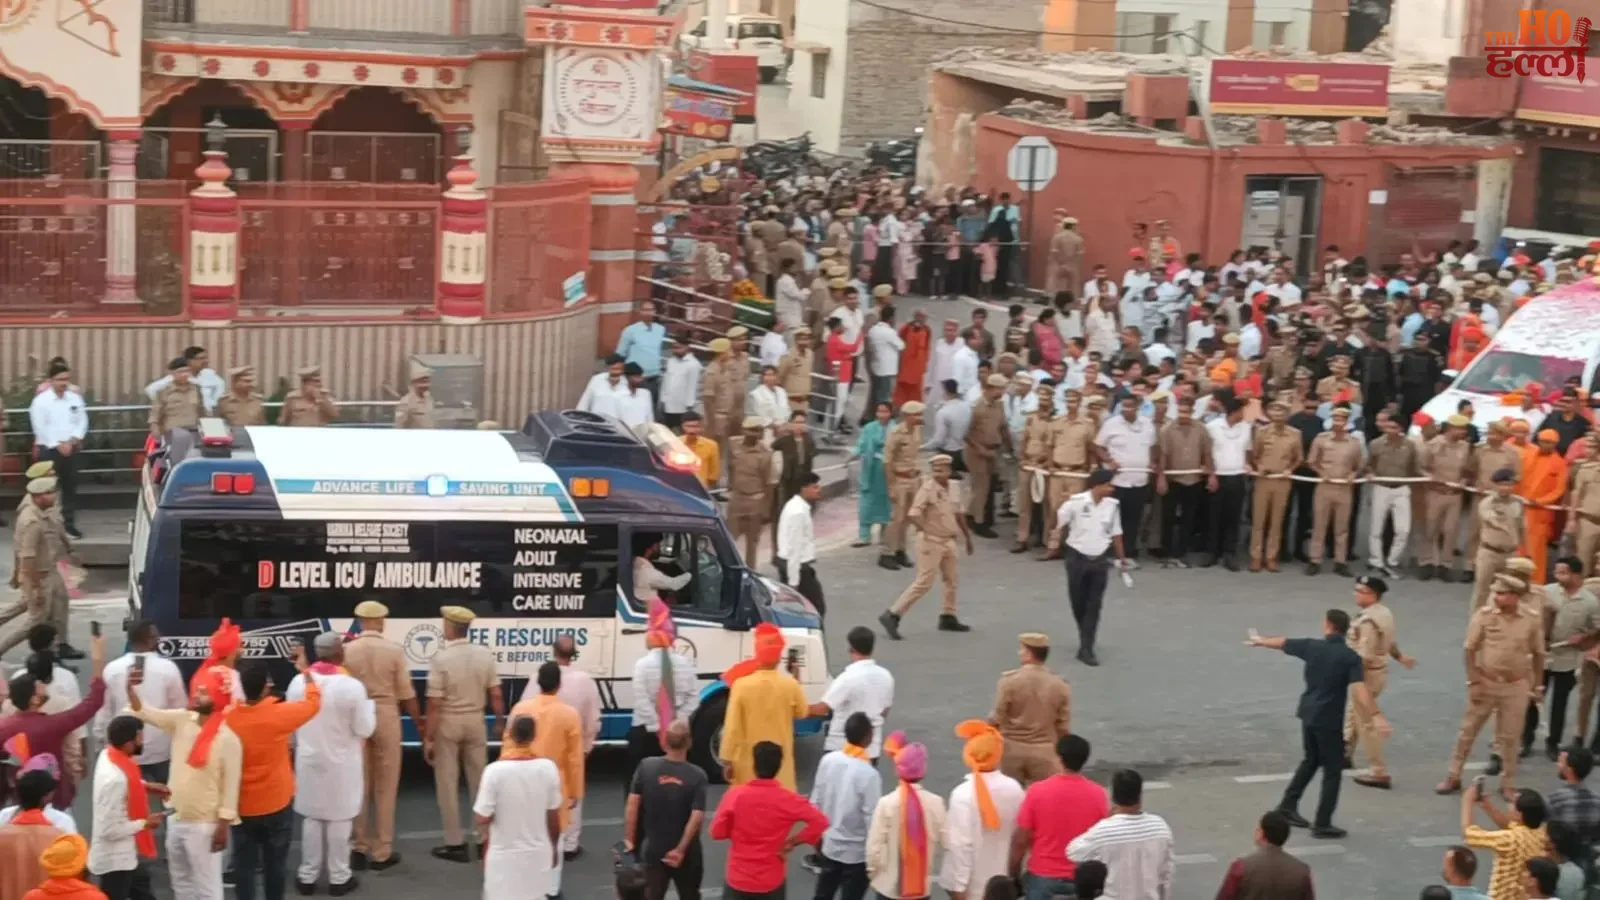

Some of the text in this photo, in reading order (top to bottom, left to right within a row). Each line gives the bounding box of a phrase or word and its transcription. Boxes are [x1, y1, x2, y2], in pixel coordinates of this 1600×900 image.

[312, 481, 546, 495] ADVANCE LIFE SAVING UNIT
[514, 528, 588, 544] NEONATAL
[513, 550, 557, 566] ADULT
[258, 560, 482, 588] D LEVEL ICU AMBULANCE
[513, 572, 583, 588] INTENSIVE
[512, 594, 586, 610] CARE UNIT
[507, 651, 550, 662] BEFORE
